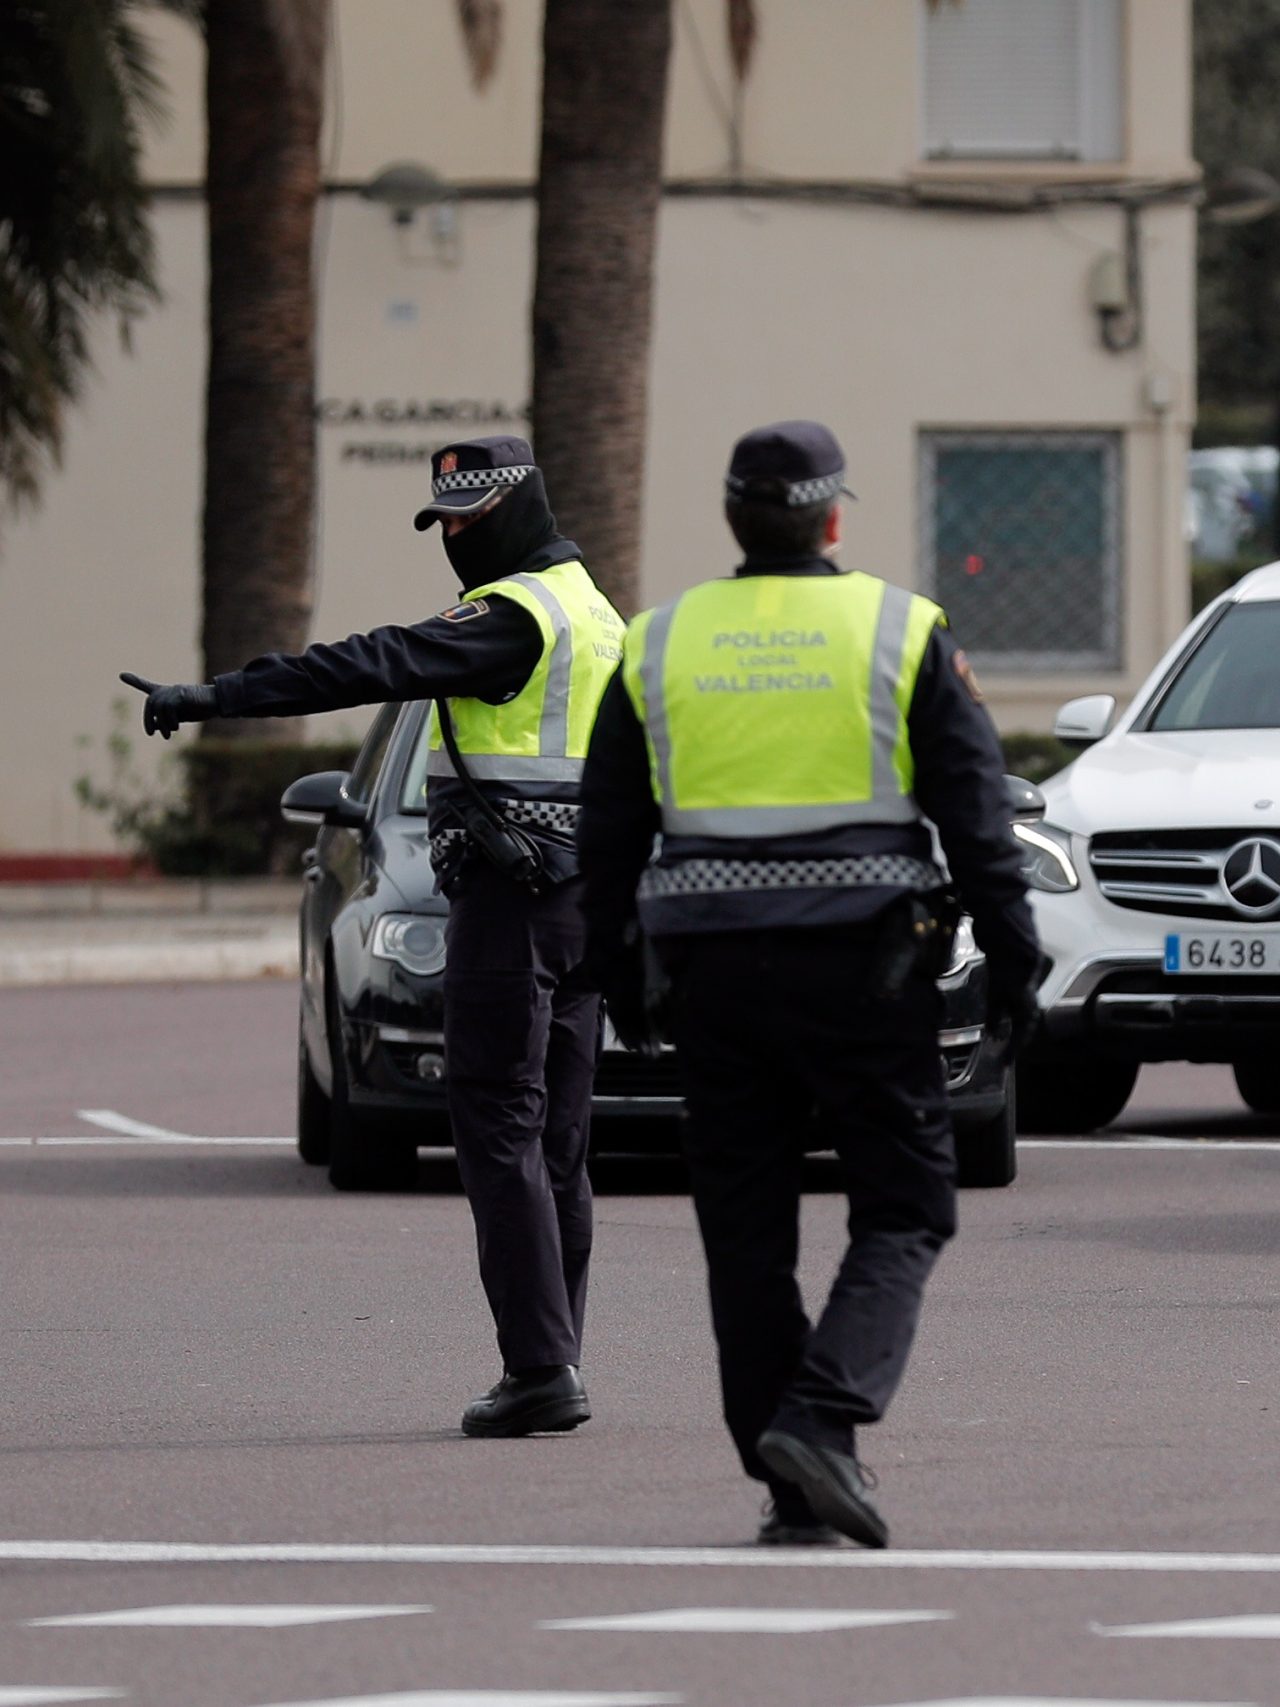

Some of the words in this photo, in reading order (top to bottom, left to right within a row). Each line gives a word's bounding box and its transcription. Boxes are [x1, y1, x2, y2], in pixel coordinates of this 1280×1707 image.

[371, 398, 514, 424] GARCIA
[712, 630, 827, 648] POLICIA
[737, 654, 798, 667] LOCAL
[1188, 939, 1266, 968] 6438
